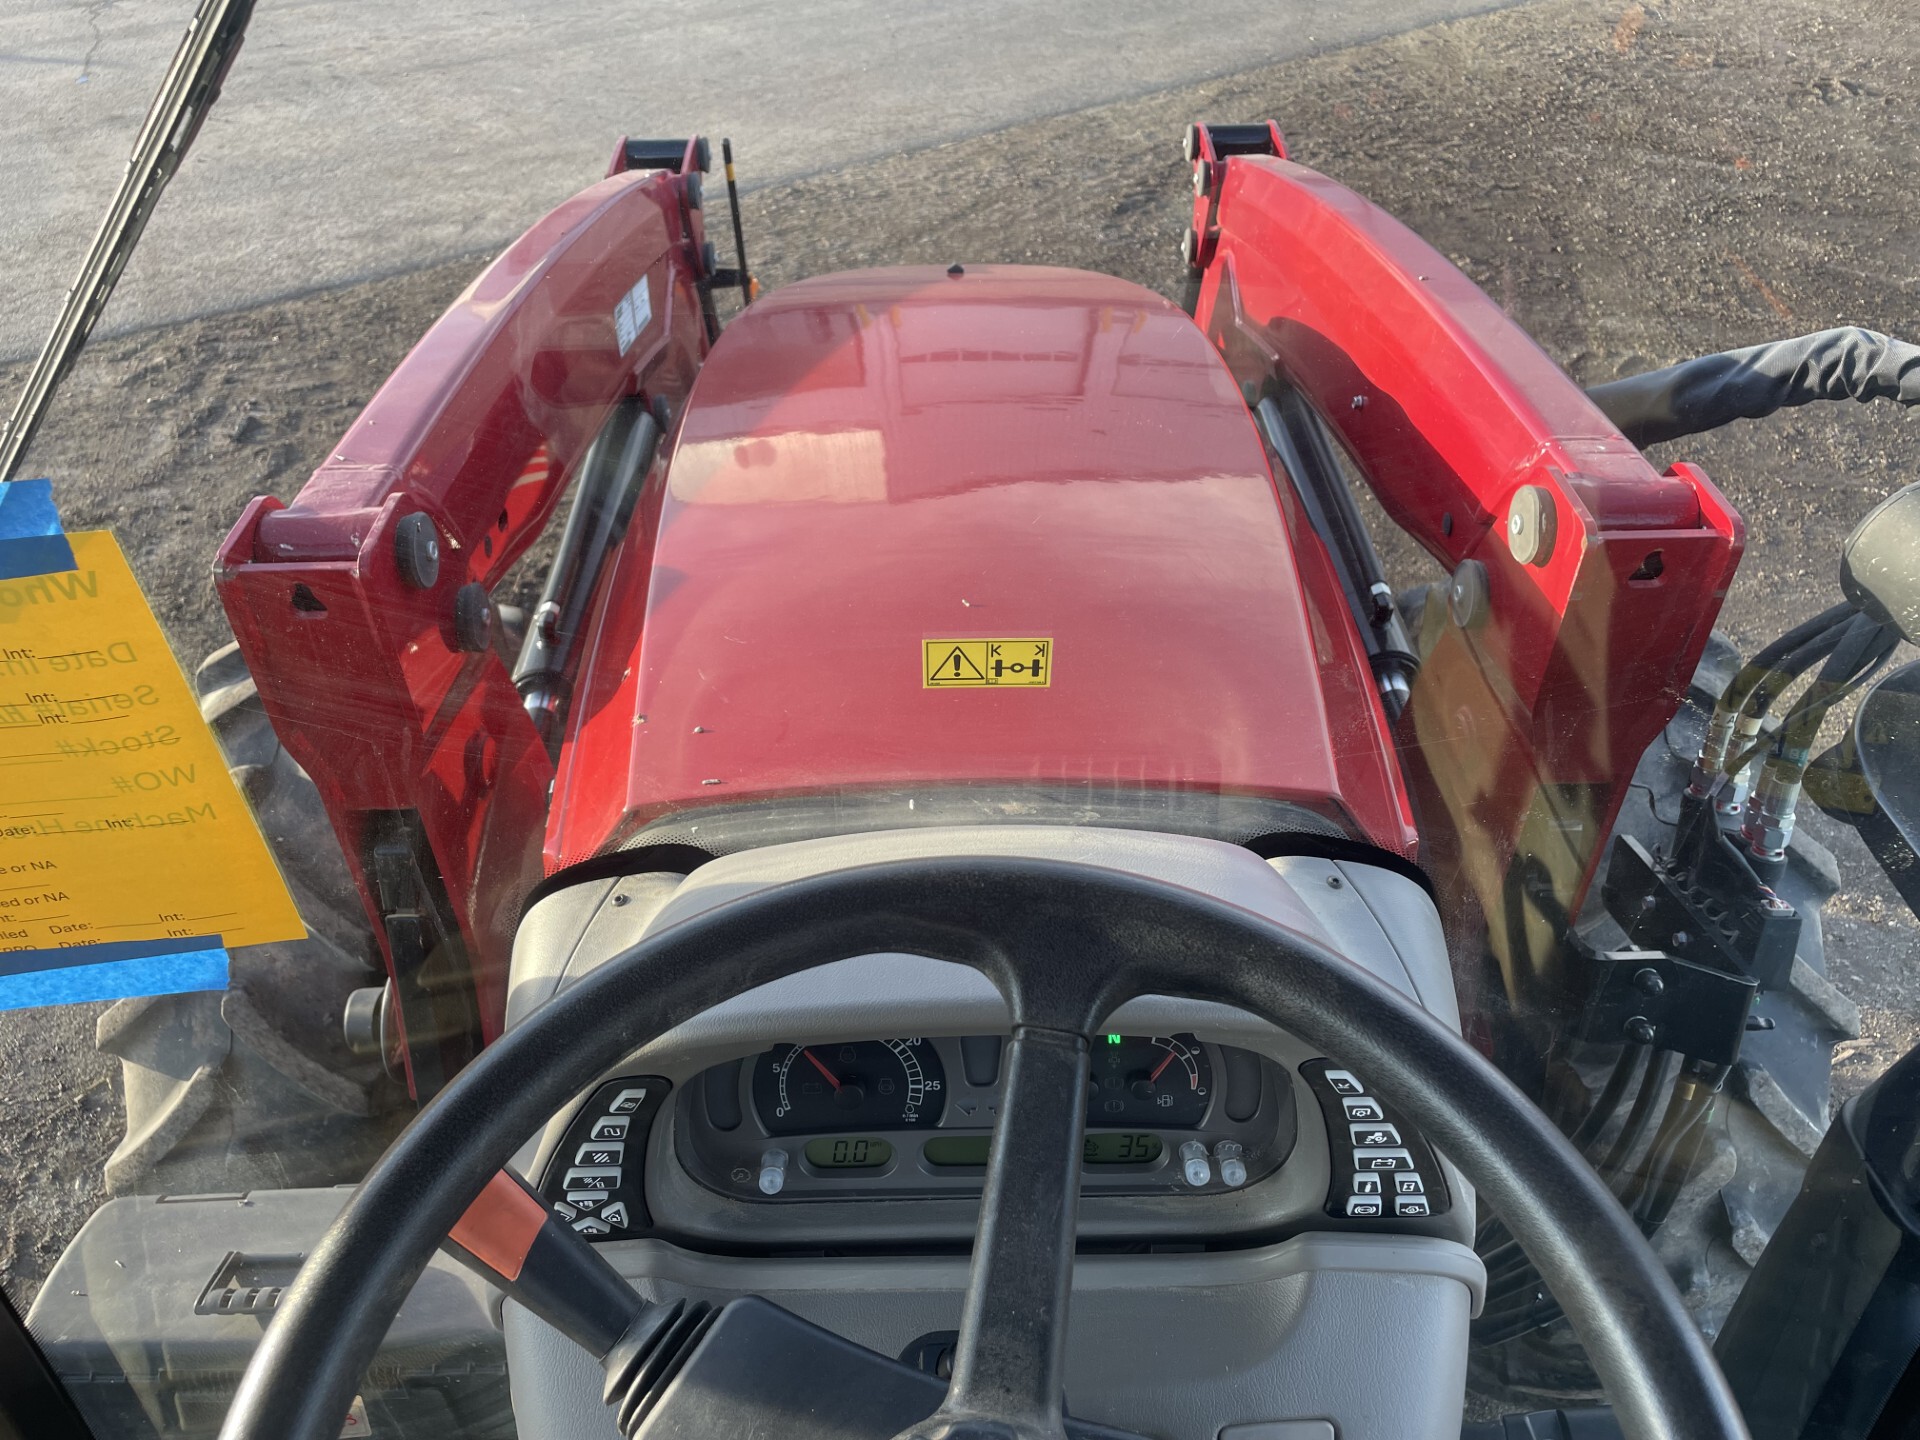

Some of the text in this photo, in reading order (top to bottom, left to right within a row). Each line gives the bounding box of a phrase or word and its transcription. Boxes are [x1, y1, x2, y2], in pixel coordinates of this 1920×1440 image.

[2, 648, 36, 660] Int:
[25, 692, 58, 704] Int:
[38, 713, 69, 725] Int:
[105, 819, 134, 829] Int:
[10, 865, 26, 873] or
[30, 860, 58, 871] NA
[24, 896, 40, 905] or
[42, 891, 70, 903] NA
[49, 922, 94, 935] Date:
[158, 912, 187, 923] Int:
[166, 927, 194, 938] Int:
[905, 1038, 921, 1046] 20
[1108, 1034, 1121, 1044] N
[772, 1063, 781, 1074] 5
[924, 1080, 941, 1091] 25
[776, 1107, 785, 1118] 0
[832, 1139, 869, 1163] 0.0
[1118, 1134, 1150, 1158] 35
